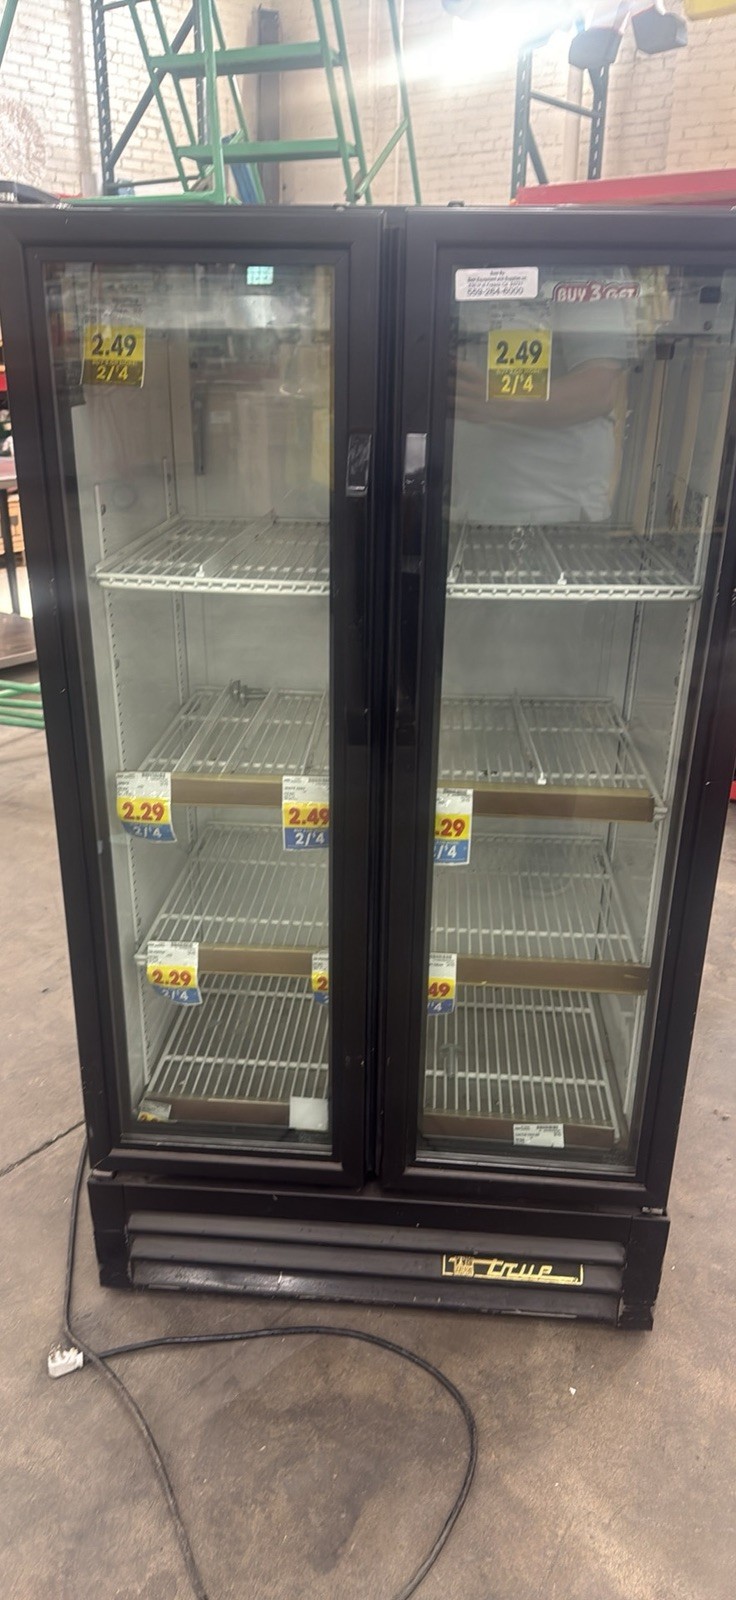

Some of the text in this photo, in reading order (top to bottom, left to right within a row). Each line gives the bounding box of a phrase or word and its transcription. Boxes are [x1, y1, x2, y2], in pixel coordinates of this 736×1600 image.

[557, 287, 587, 302] BUY
[590, 284, 602, 301] 3
[92, 333, 137, 356] 2.49
[496, 340, 543, 366] 2.49
[122, 802, 165, 822] 2.29
[288, 807, 329, 826] 2.49
[435, 818, 466, 837] .29
[434, 844, 457, 860] /$4
[152, 969, 192, 987] 2.29
[428, 982, 451, 998] 49
